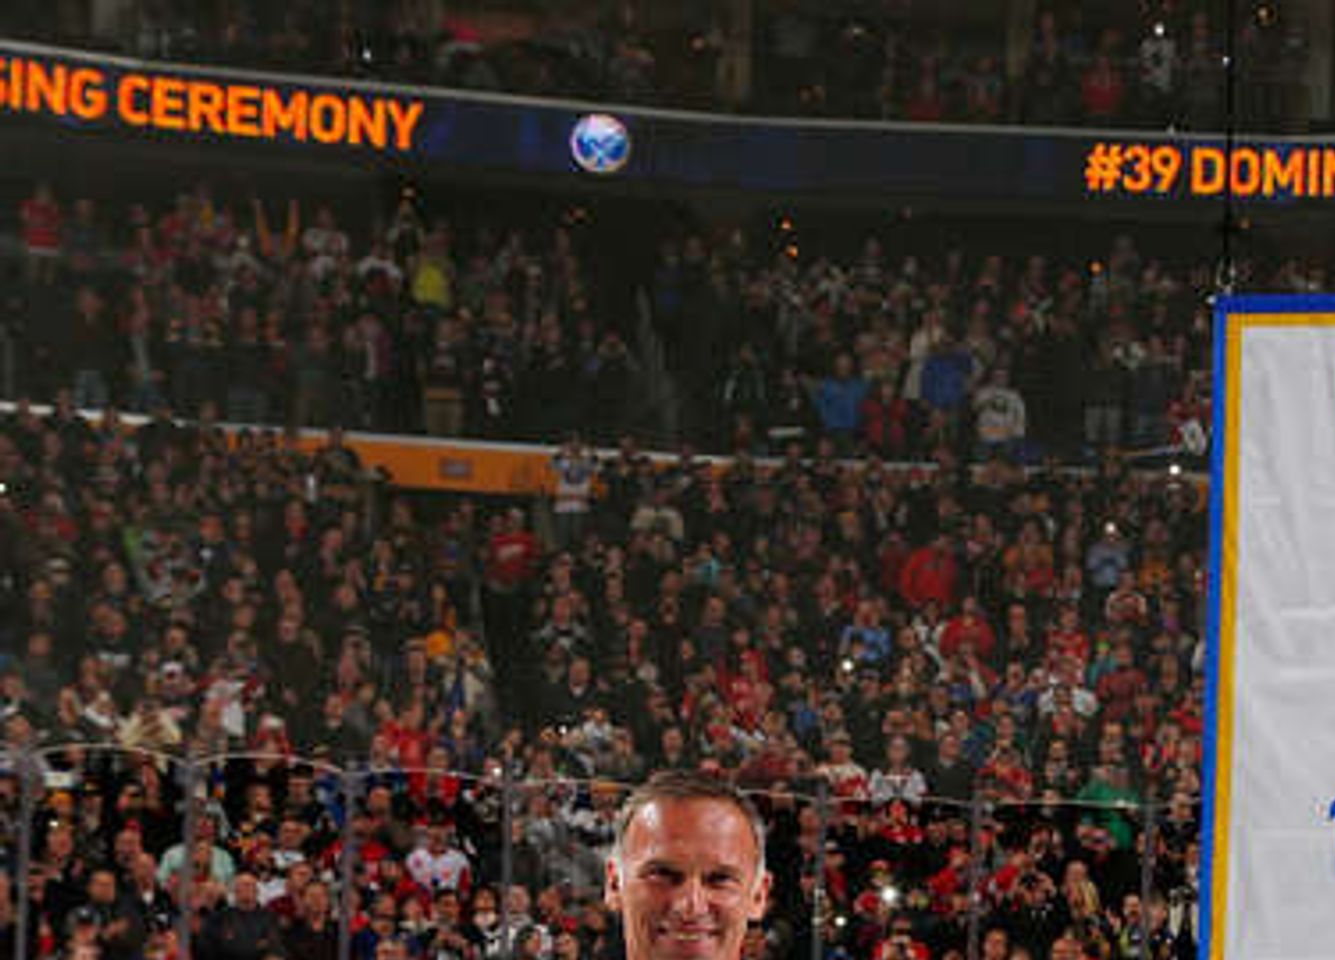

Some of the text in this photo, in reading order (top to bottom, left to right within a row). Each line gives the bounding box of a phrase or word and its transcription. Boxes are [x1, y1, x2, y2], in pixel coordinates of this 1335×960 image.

[0, 56, 424, 150] ING CEREMONY
[1084, 143, 1182, 192] #39
